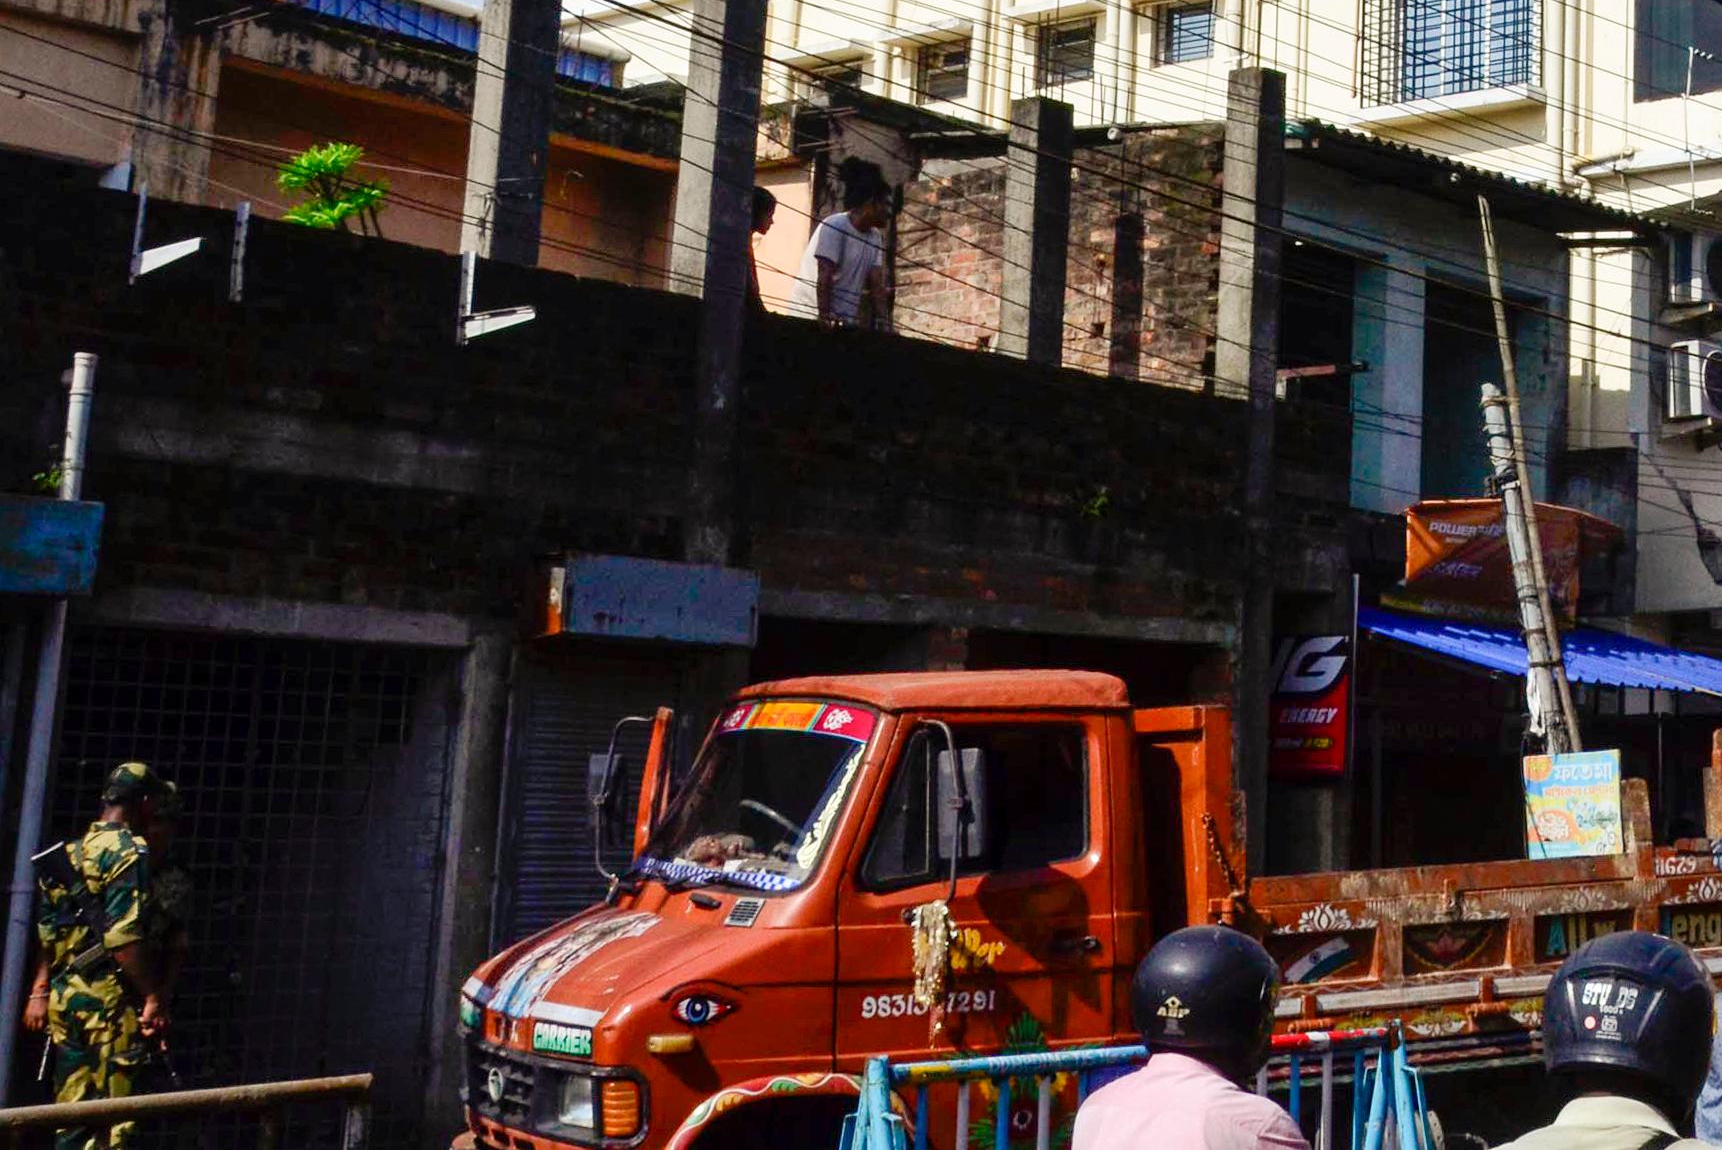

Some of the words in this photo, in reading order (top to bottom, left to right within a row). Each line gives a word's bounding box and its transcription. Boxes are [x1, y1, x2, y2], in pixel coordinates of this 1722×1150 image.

[1280, 708, 1338, 723] ENERGY
[861, 991, 996, 1018] 98317291
[533, 1022, 592, 1055] CARRIER
